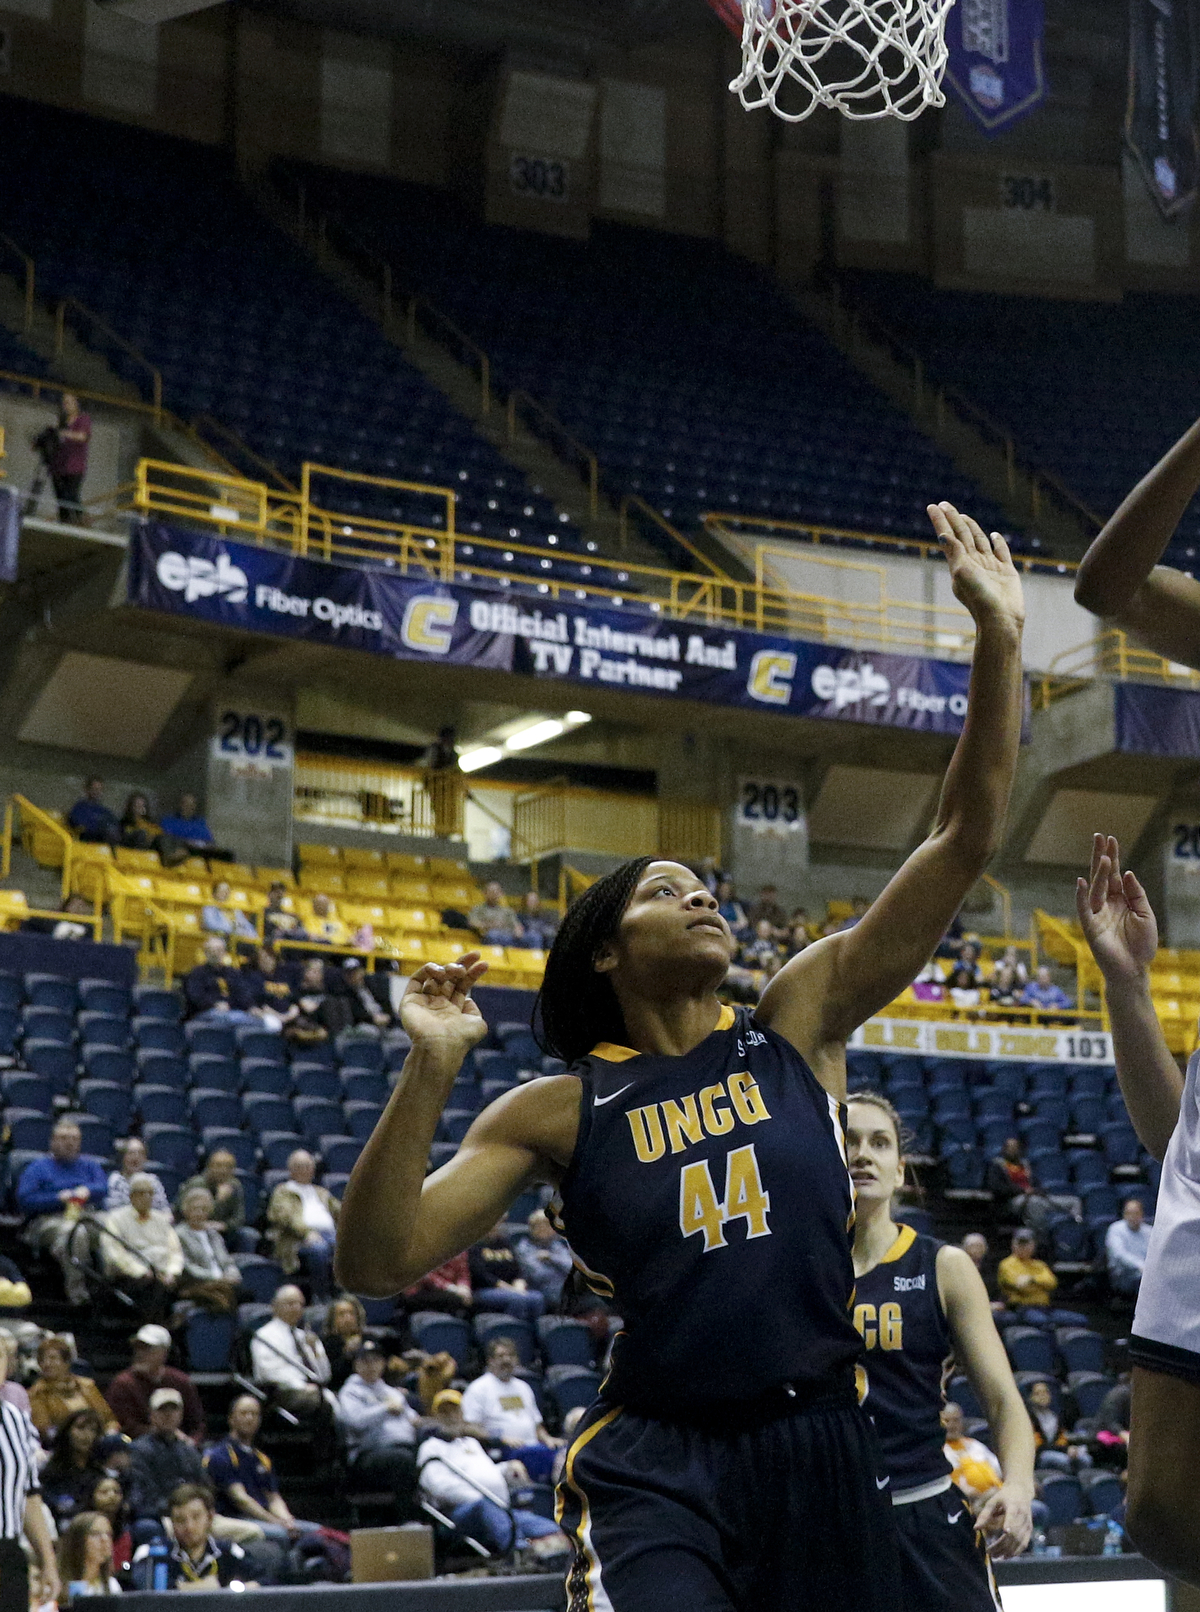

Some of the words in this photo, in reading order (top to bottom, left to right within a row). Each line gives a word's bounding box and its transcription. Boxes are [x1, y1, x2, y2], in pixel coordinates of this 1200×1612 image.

[511, 156, 569, 197] 303
[1004, 177, 1052, 210] 304
[156, 550, 248, 603] epb
[255, 584, 312, 618] Fiber
[312, 596, 384, 630] Optics
[469, 599, 570, 644] Official
[573, 616, 681, 662] Internet
[684, 634, 738, 671] And
[529, 640, 575, 675] TV
[579, 648, 684, 692] Partner
[811, 662, 891, 710] epb
[896, 686, 947, 714] Fiber
[221, 711, 285, 760] 202
[744, 782, 799, 824] 203
[737, 1029, 769, 1058] SCON
[1065, 1036, 1107, 1060] 103
[624, 1069, 772, 1164] UNCG
[679, 1142, 773, 1254] 44
